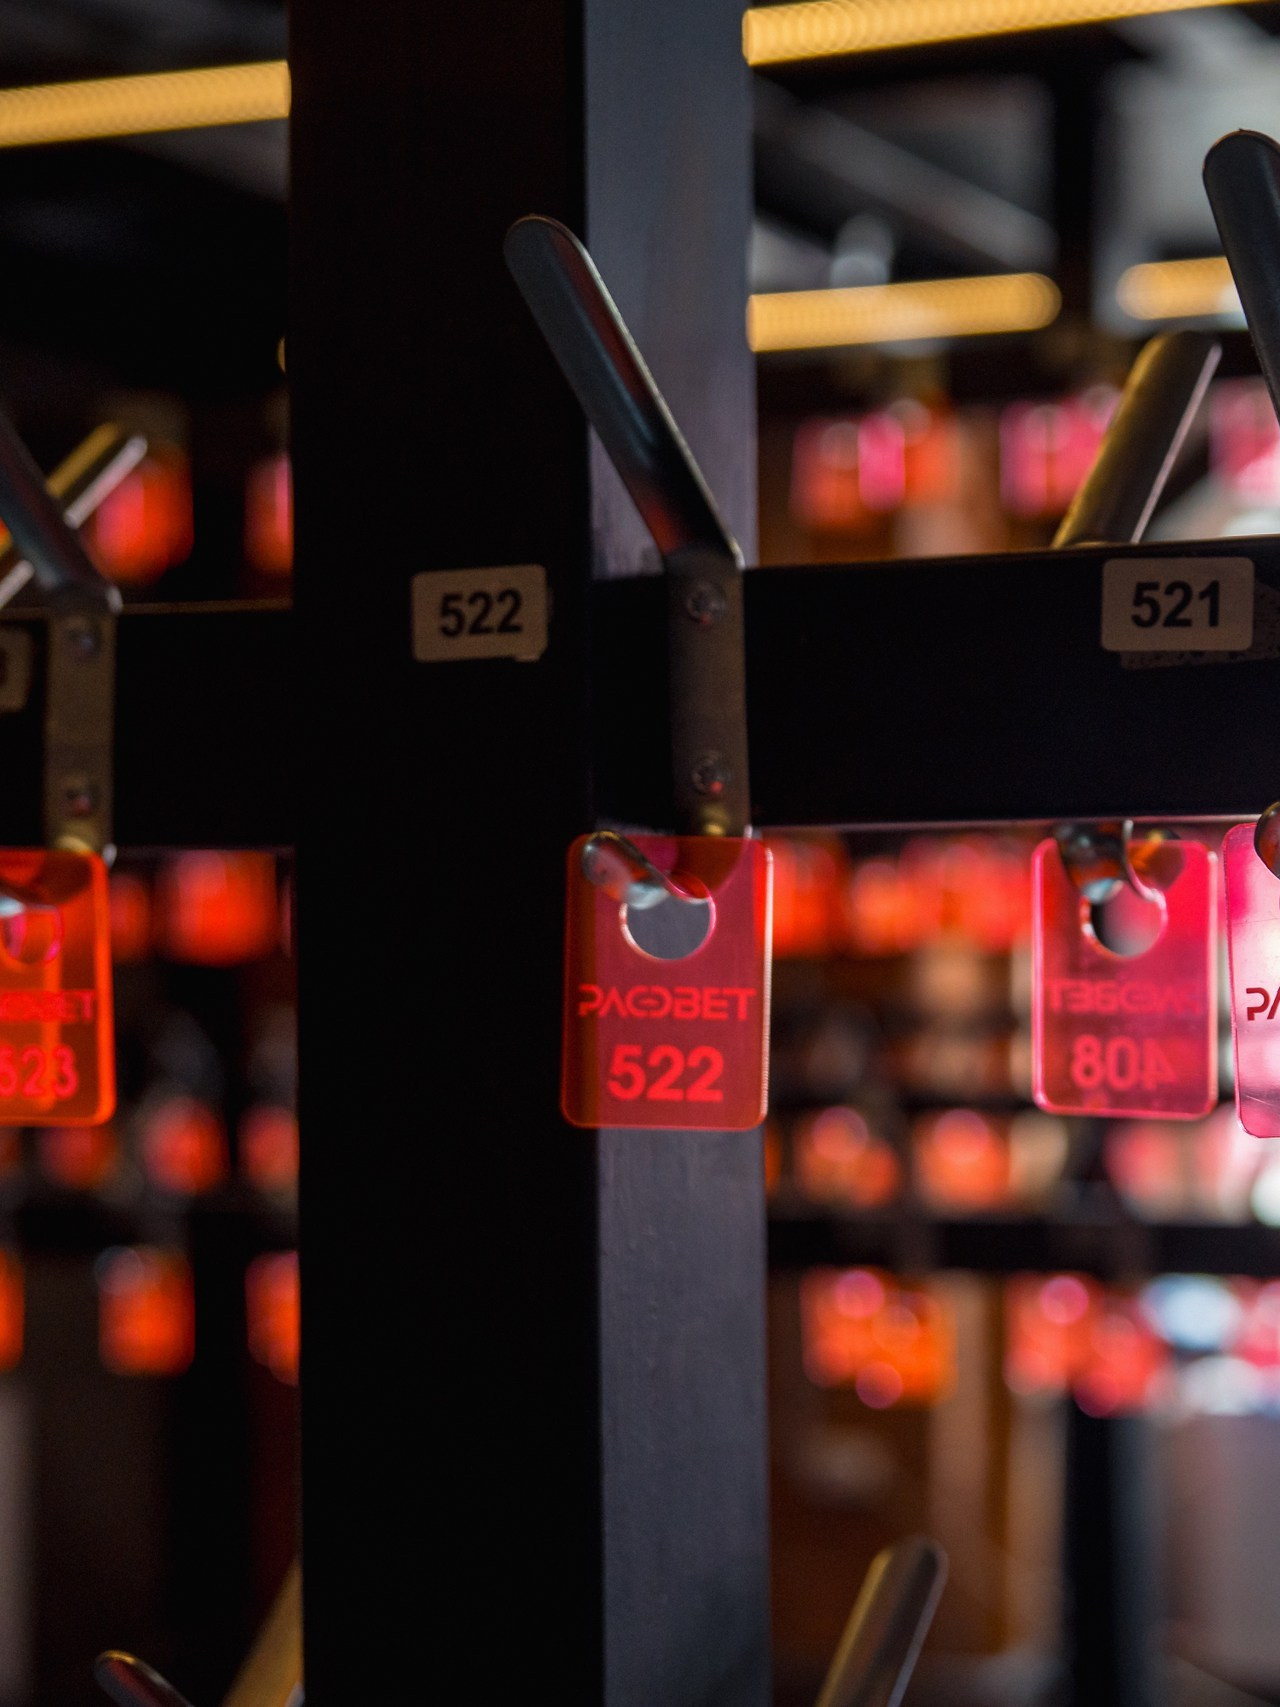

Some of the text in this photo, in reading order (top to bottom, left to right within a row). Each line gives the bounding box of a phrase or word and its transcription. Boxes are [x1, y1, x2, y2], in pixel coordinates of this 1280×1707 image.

[440, 589, 522, 637] 522
[1131, 581, 1220, 628] 521
[607, 1044, 724, 1102] 522
